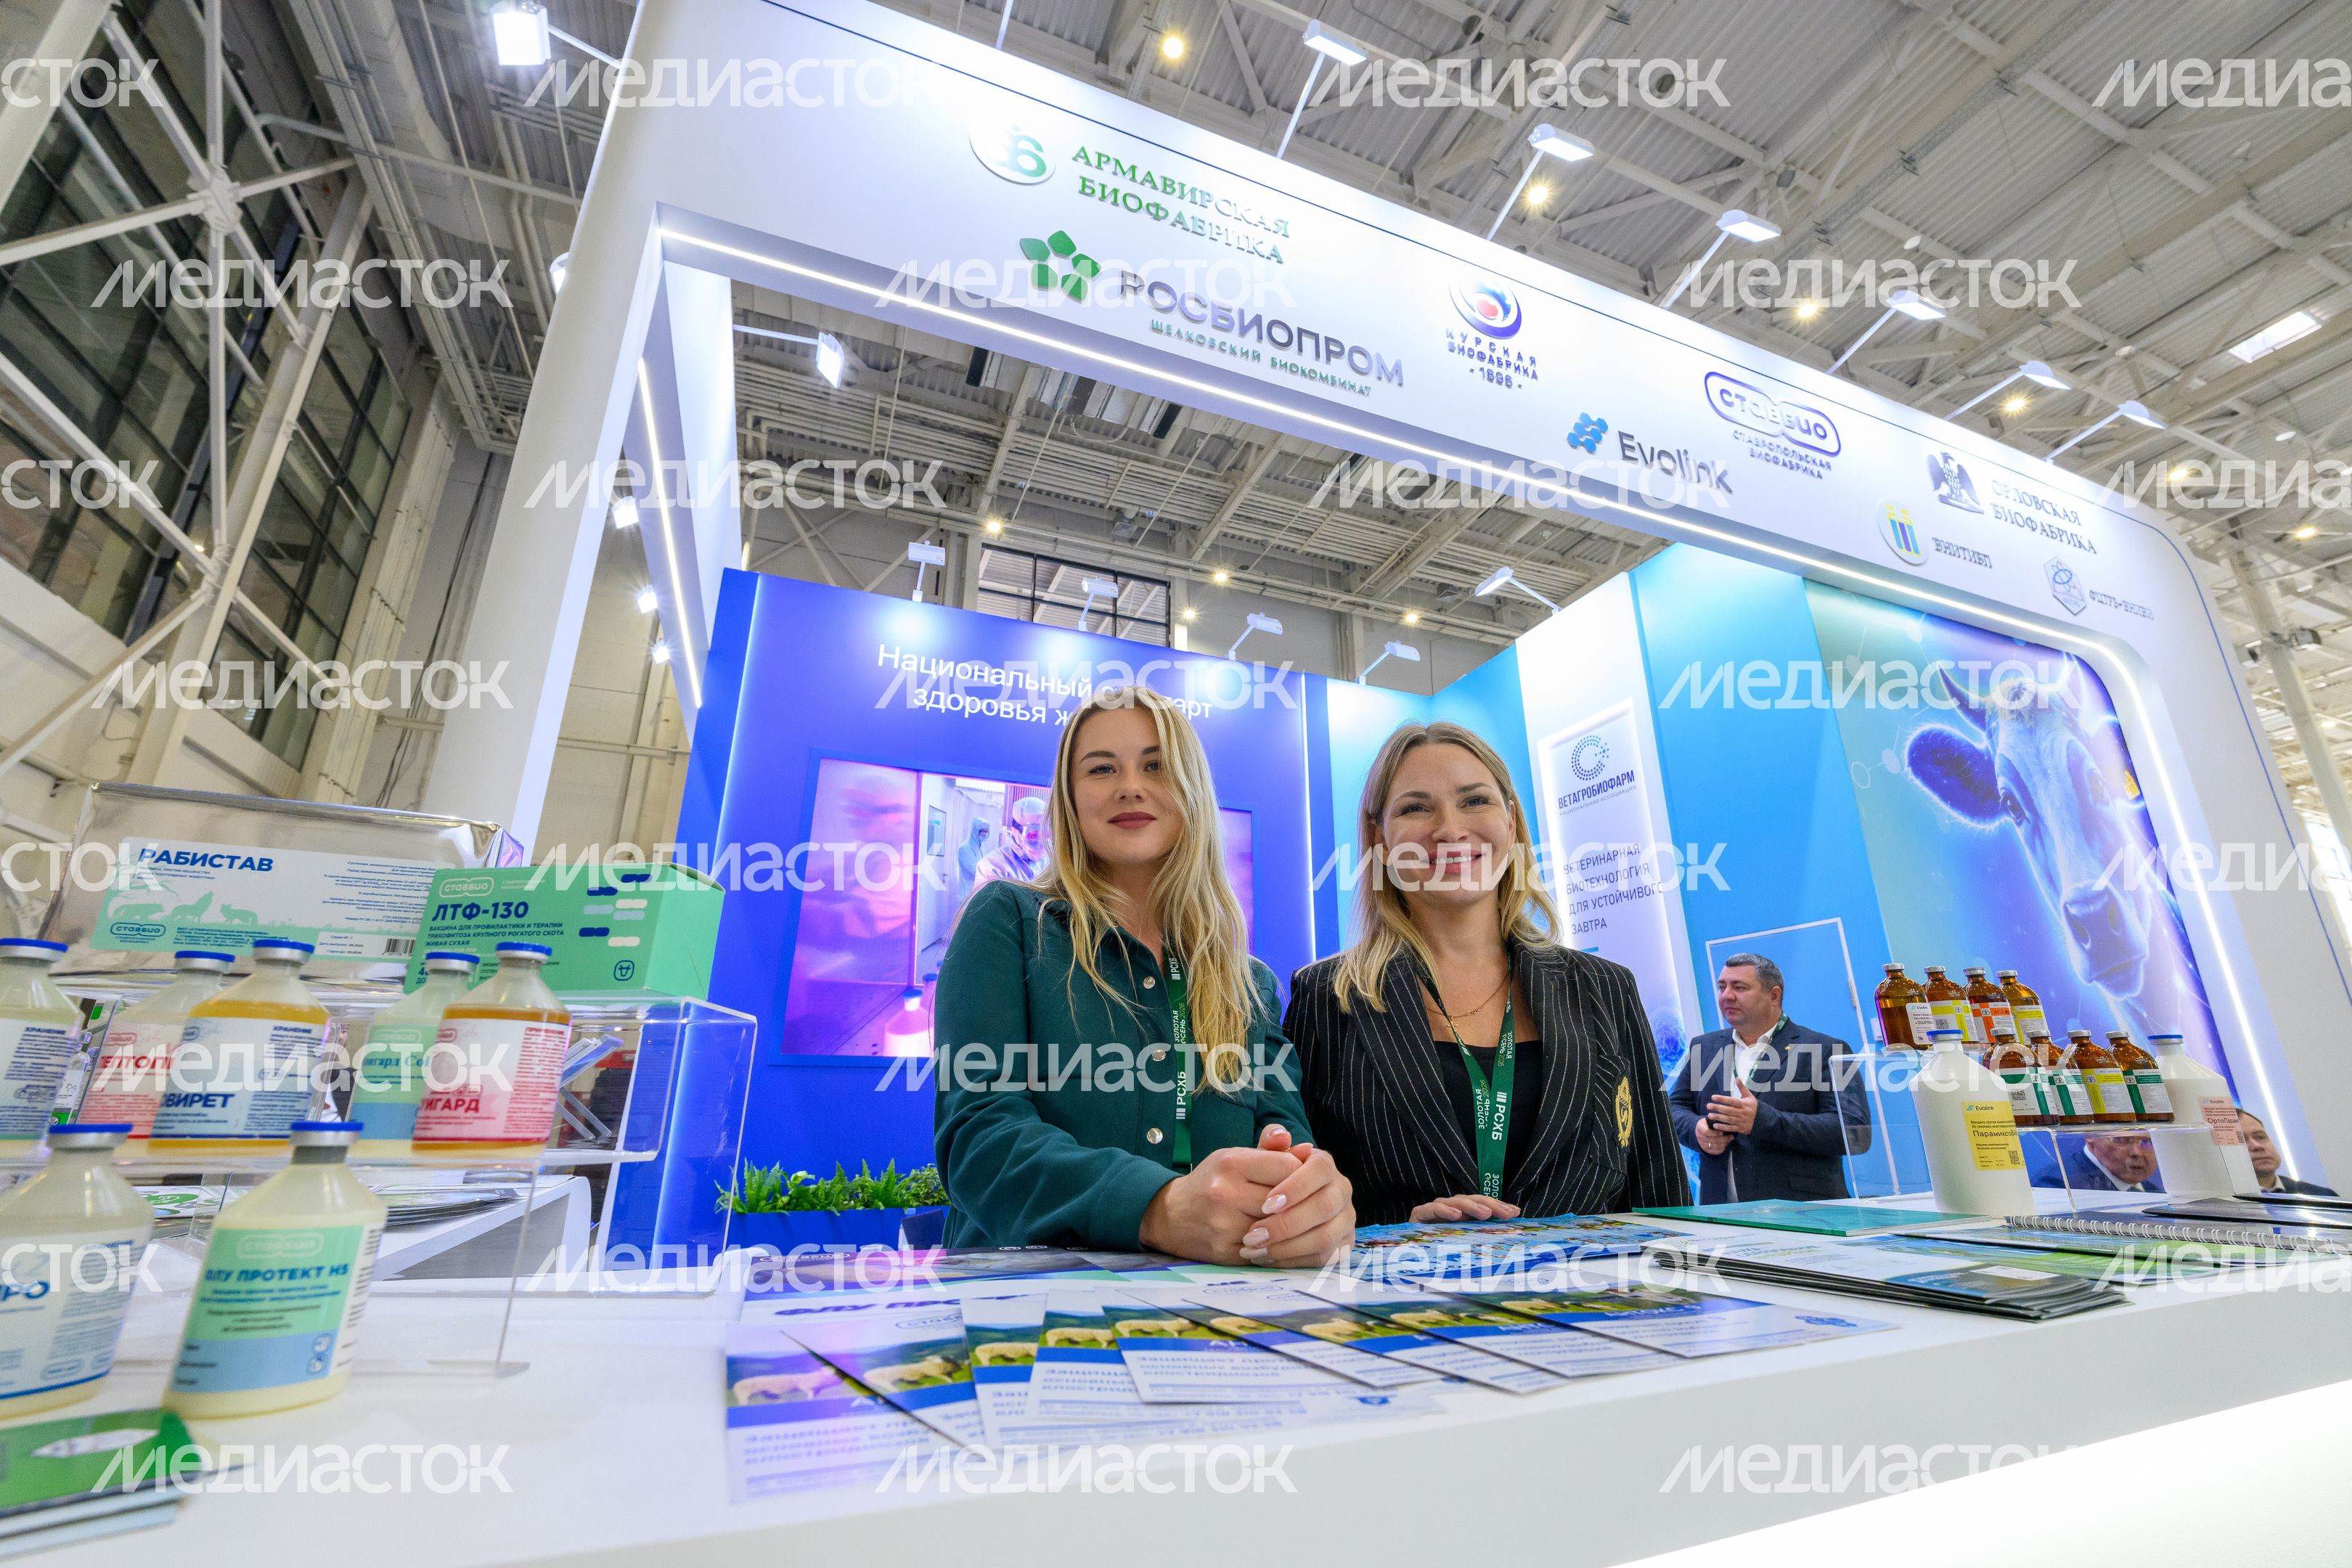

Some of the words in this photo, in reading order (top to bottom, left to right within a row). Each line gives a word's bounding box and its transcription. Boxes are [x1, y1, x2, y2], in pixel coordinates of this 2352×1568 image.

[1072, 145, 1291, 238] АРМАВИРСКАЯ
[1078, 176, 1286, 264] БИОФАБРИКА
[1120, 269, 1405, 388] РОСБИОПРОМ
[1151, 318, 1262, 362] ЩЕЛКОВСКИЙ
[1270, 356, 1372, 397] БИОКОМБИНАТ
[1447, 340, 1539, 383] БИОФАБРИКА
[1617, 428, 1734, 496] Evolink
[1732, 429, 1832, 472] СТАВРОПОЛЬСКАЯ
[1748, 447, 1824, 481] БИОФАБРИКА
[1990, 478, 2083, 527] ОРЛОВСКАЯ
[1990, 502, 2098, 556] БИОФАБРИКА
[877, 643, 1092, 698] Национальный
[912, 687, 1047, 726] здоровья
[1558, 769, 1636, 810] ВЕТАГРОБИОФАРМ
[138, 848, 274, 872] РАБИСТАВ
[1563, 843, 1641, 875] ВЕТЕРИНАРНАЯ
[1566, 862, 1650, 895] БИОТЕХНОЛОГИЯ
[431, 901, 529, 922] ЛТФ-130
[1569, 898, 1589, 918] ДЛЯ
[1571, 917, 1608, 936] ЗАВТРА
[163, 1093, 235, 1108] ВИРЕТ
[1176, 1071, 1187, 1106] РСХБ
[1475, 1088, 1485, 1130] ЗОЛОТАЯ
[1491, 1103, 1506, 1141] РСХБ
